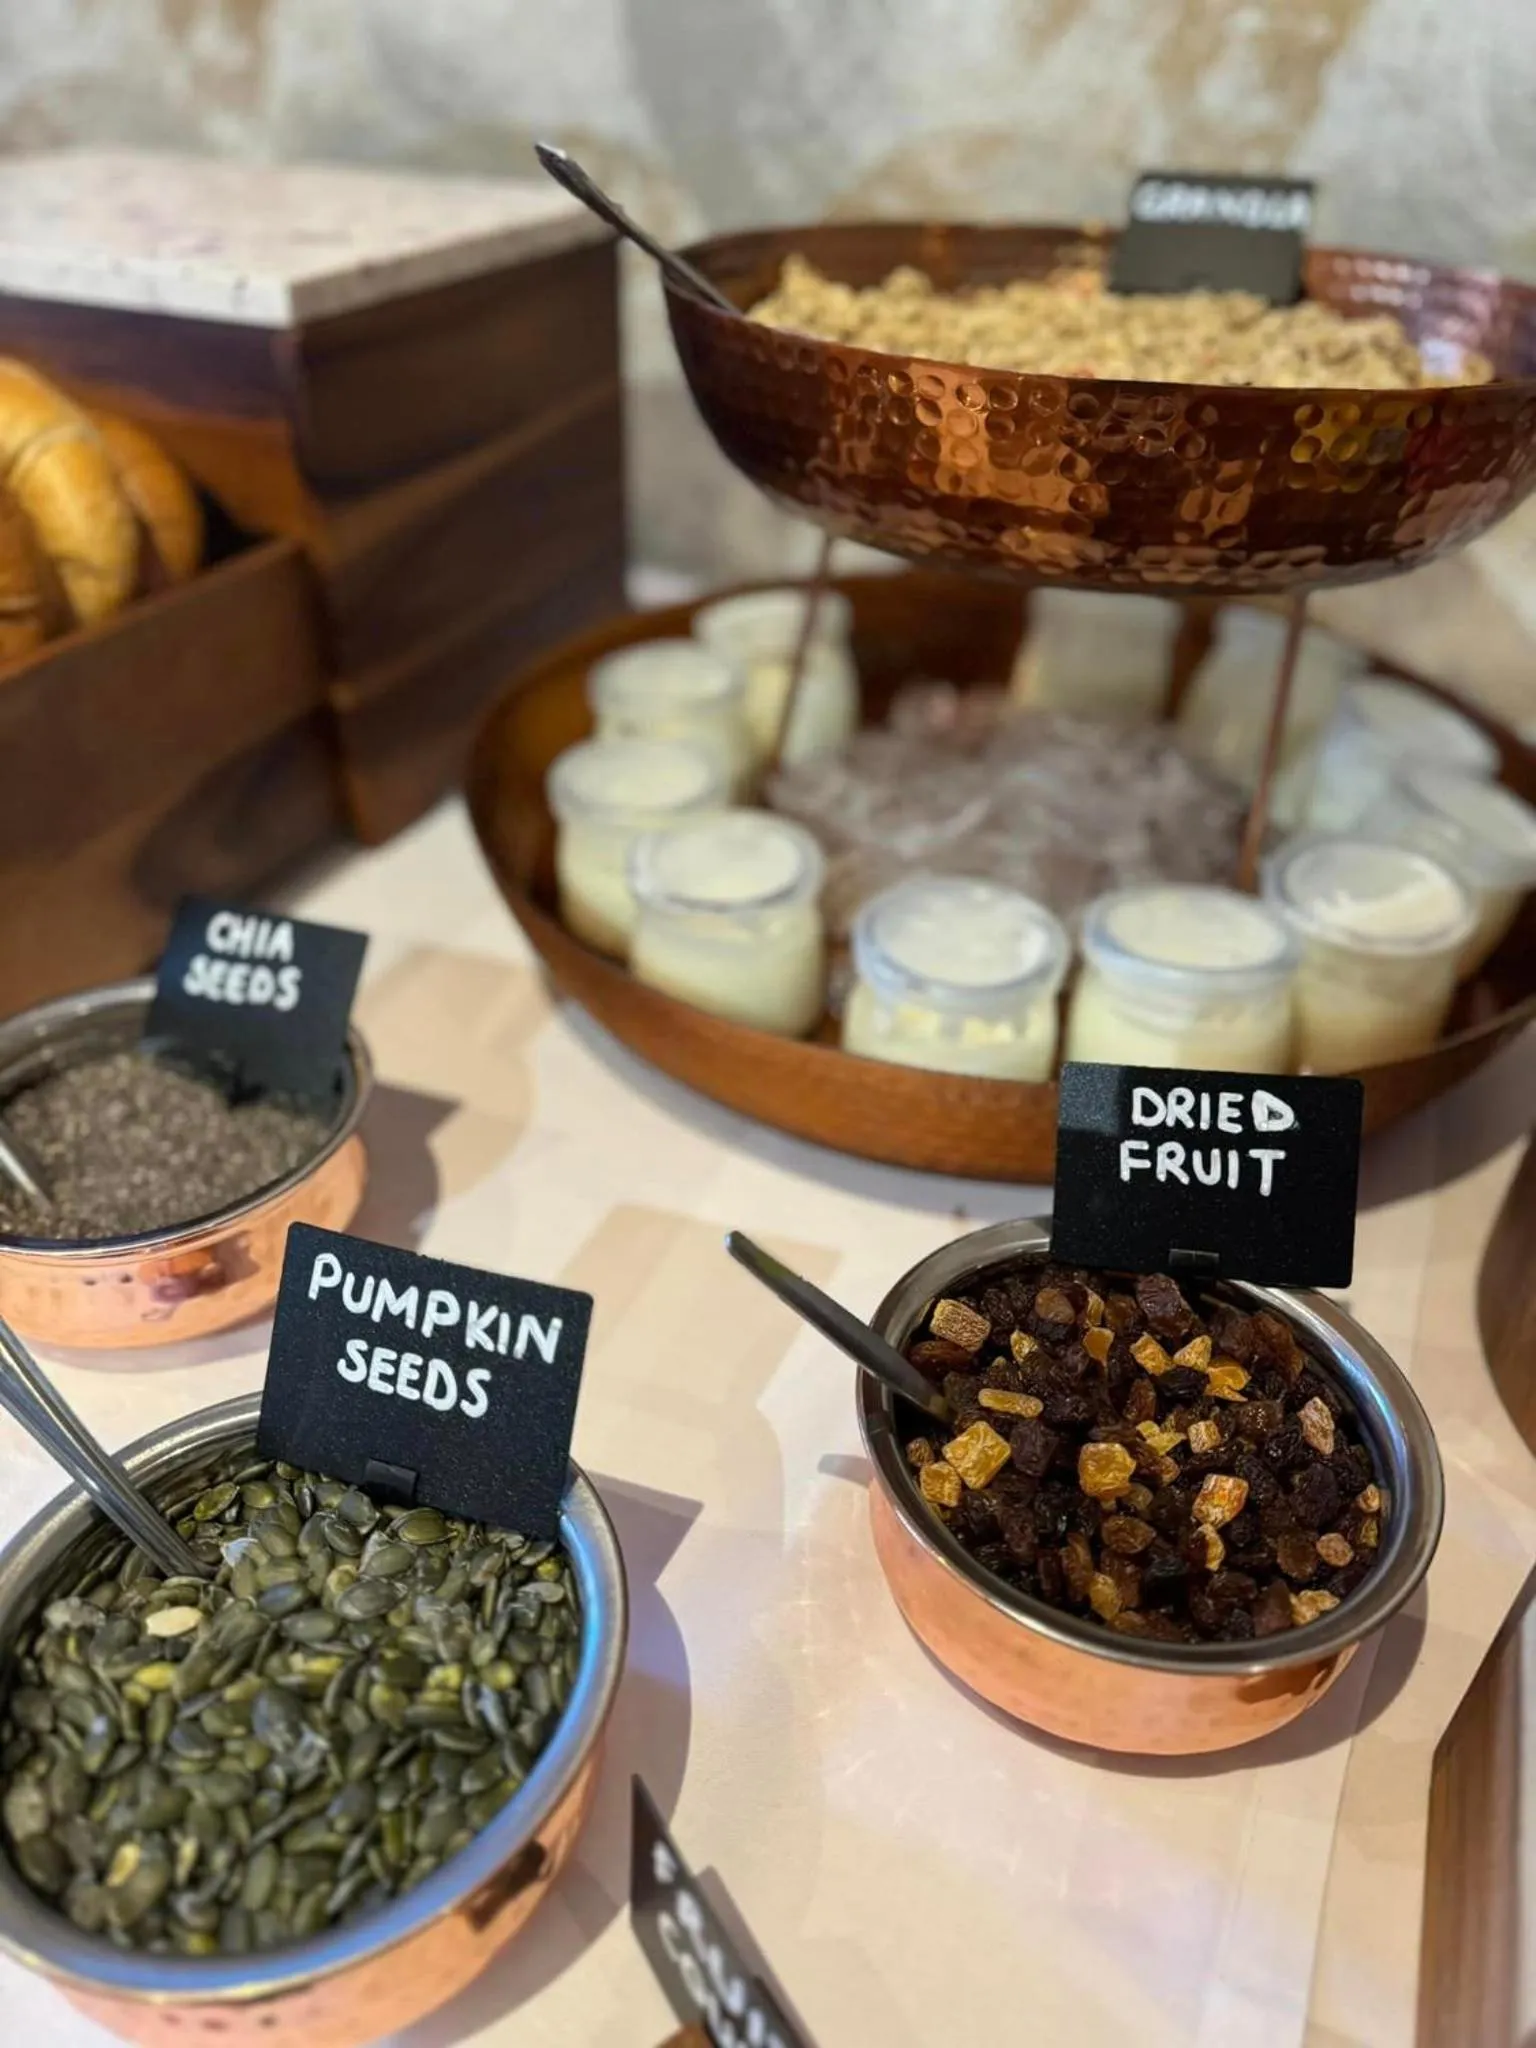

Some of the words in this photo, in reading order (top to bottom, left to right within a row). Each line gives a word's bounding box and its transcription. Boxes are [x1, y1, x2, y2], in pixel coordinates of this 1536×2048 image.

[206, 911, 294, 963] CHIA
[183, 954, 301, 1012] SEEDS
[1132, 1087, 1297, 1133] DRIED
[1120, 1140, 1286, 1197] FRUIT
[308, 1253, 563, 1364] PUMPKIN
[337, 1339, 492, 1418] SEEDS
